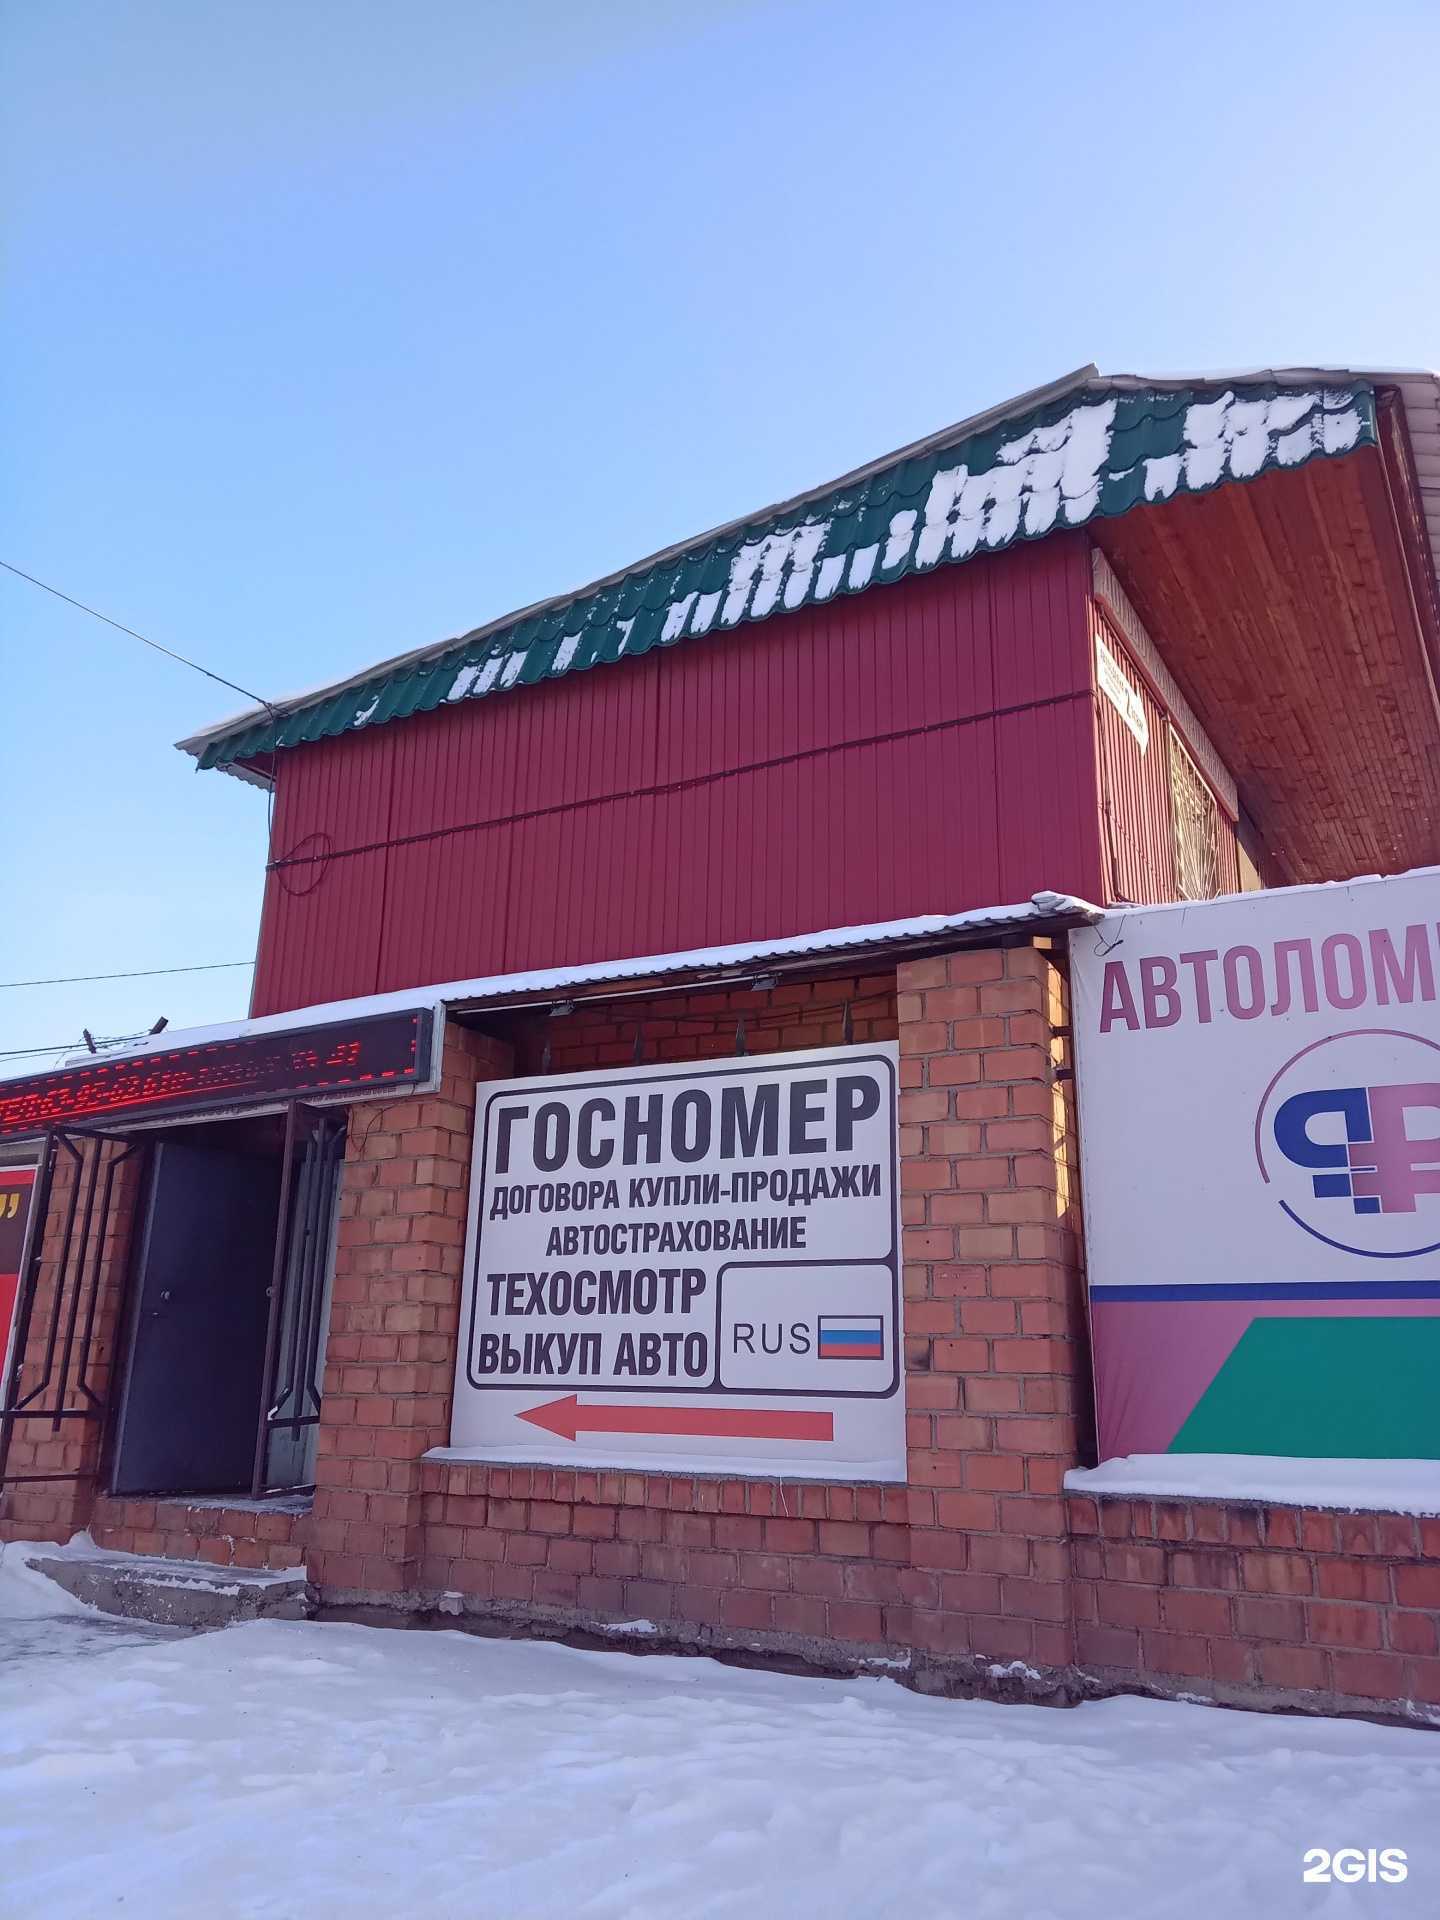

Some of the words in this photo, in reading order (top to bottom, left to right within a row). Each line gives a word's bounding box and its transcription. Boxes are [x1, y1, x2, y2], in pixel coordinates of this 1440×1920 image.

[1100, 922, 1440, 1033] АВТОЛОМ
[494, 1075, 881, 1174] ГОСНОМЕР
[490, 1180, 620, 1221] ДОГОВОРА
[629, 1163, 881, 1208] КУПЛИ-ПРОДАЖИ
[546, 1216, 807, 1256] АВТОСТРАХОВАНИЕ
[487, 1268, 707, 1316] ТЕХОСМОТР
[478, 1332, 601, 1375] ВЫКУП
[613, 1331, 708, 1377] АВТО
[733, 1322, 811, 1354] RUS
